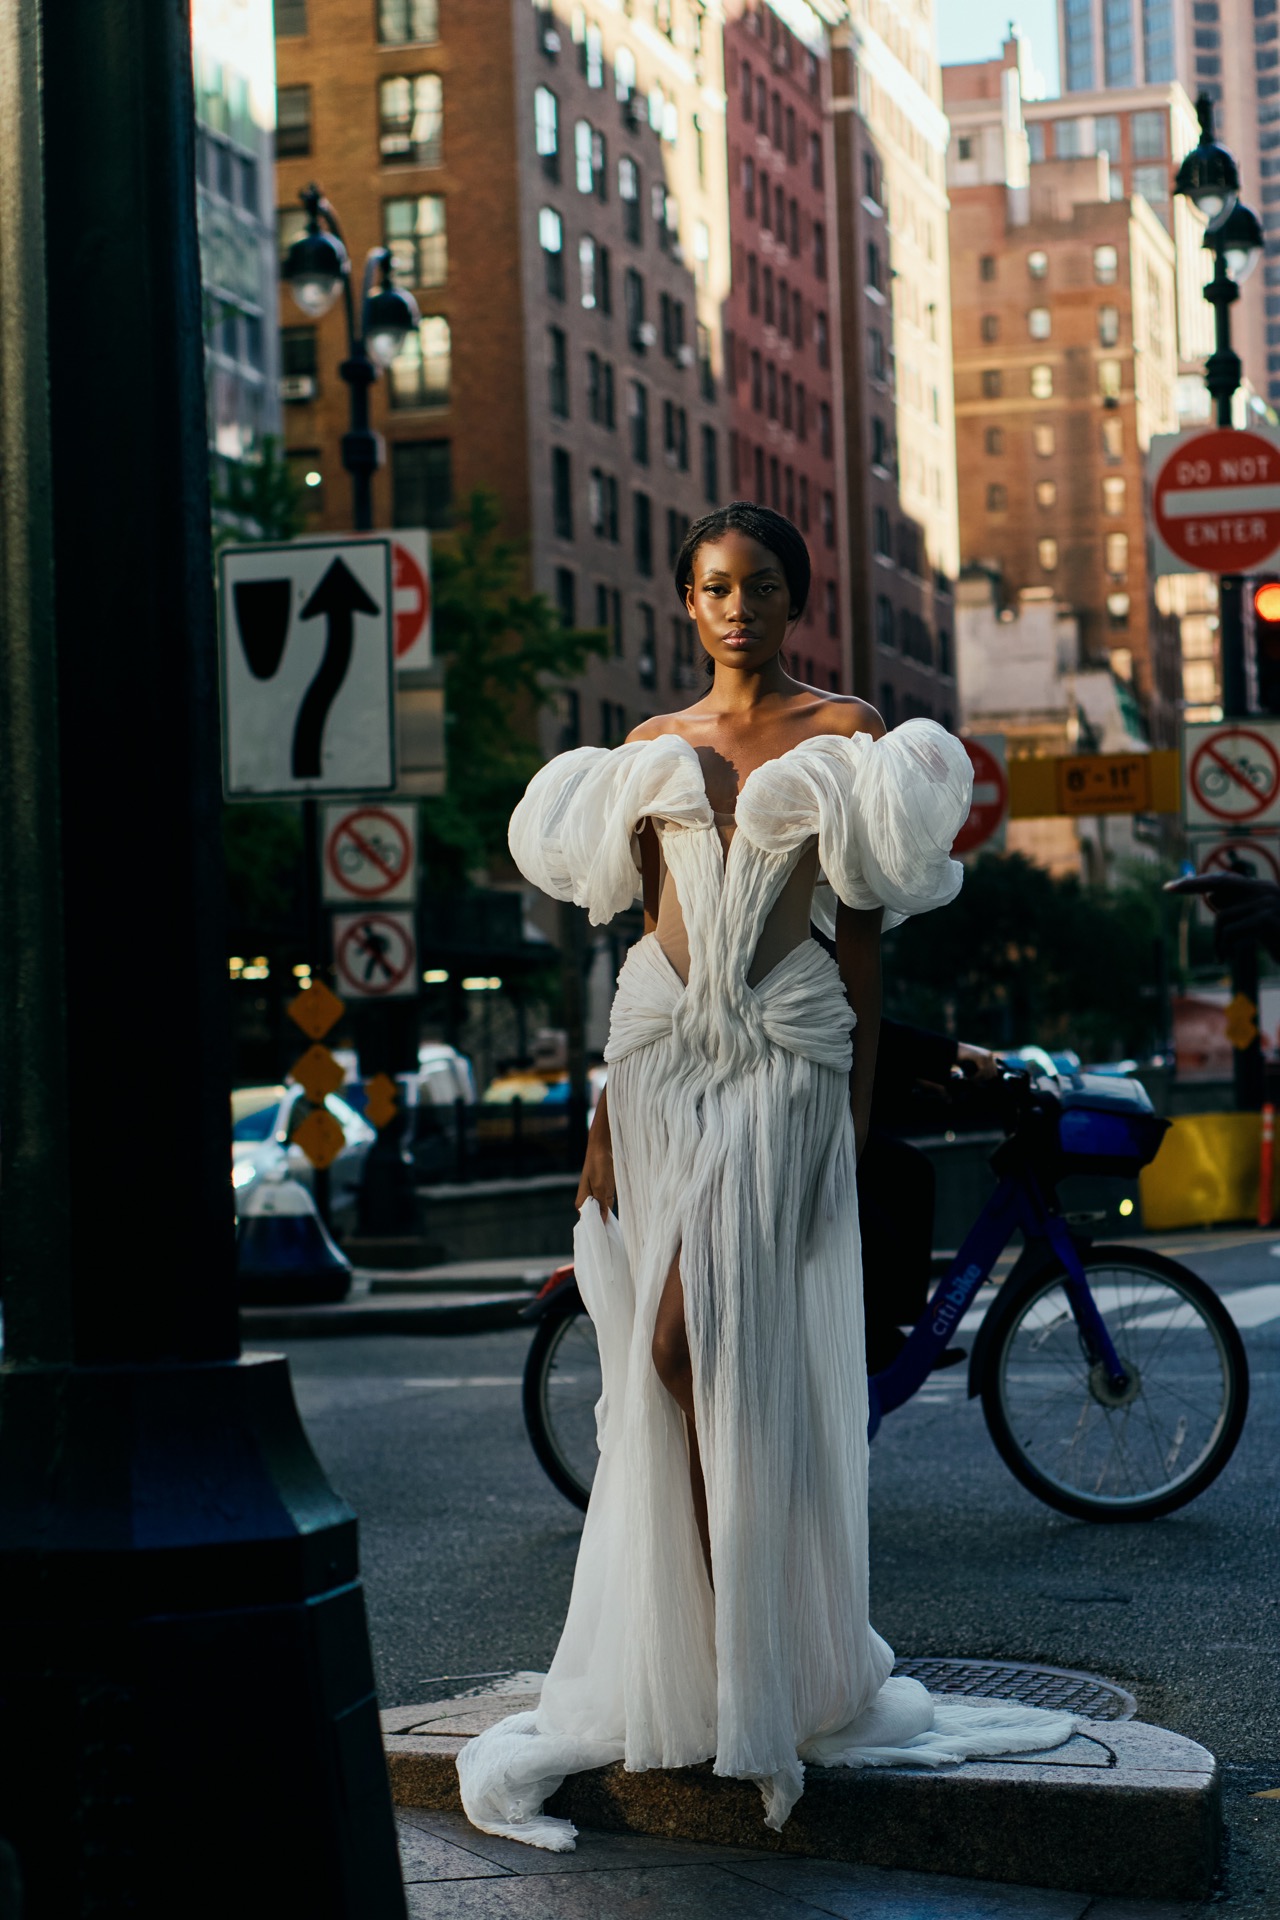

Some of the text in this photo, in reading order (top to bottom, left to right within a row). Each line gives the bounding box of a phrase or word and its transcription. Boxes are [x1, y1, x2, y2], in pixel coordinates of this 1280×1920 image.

[1177, 456, 1269, 485] DO NOT
[1185, 518, 1266, 545] ENTER
